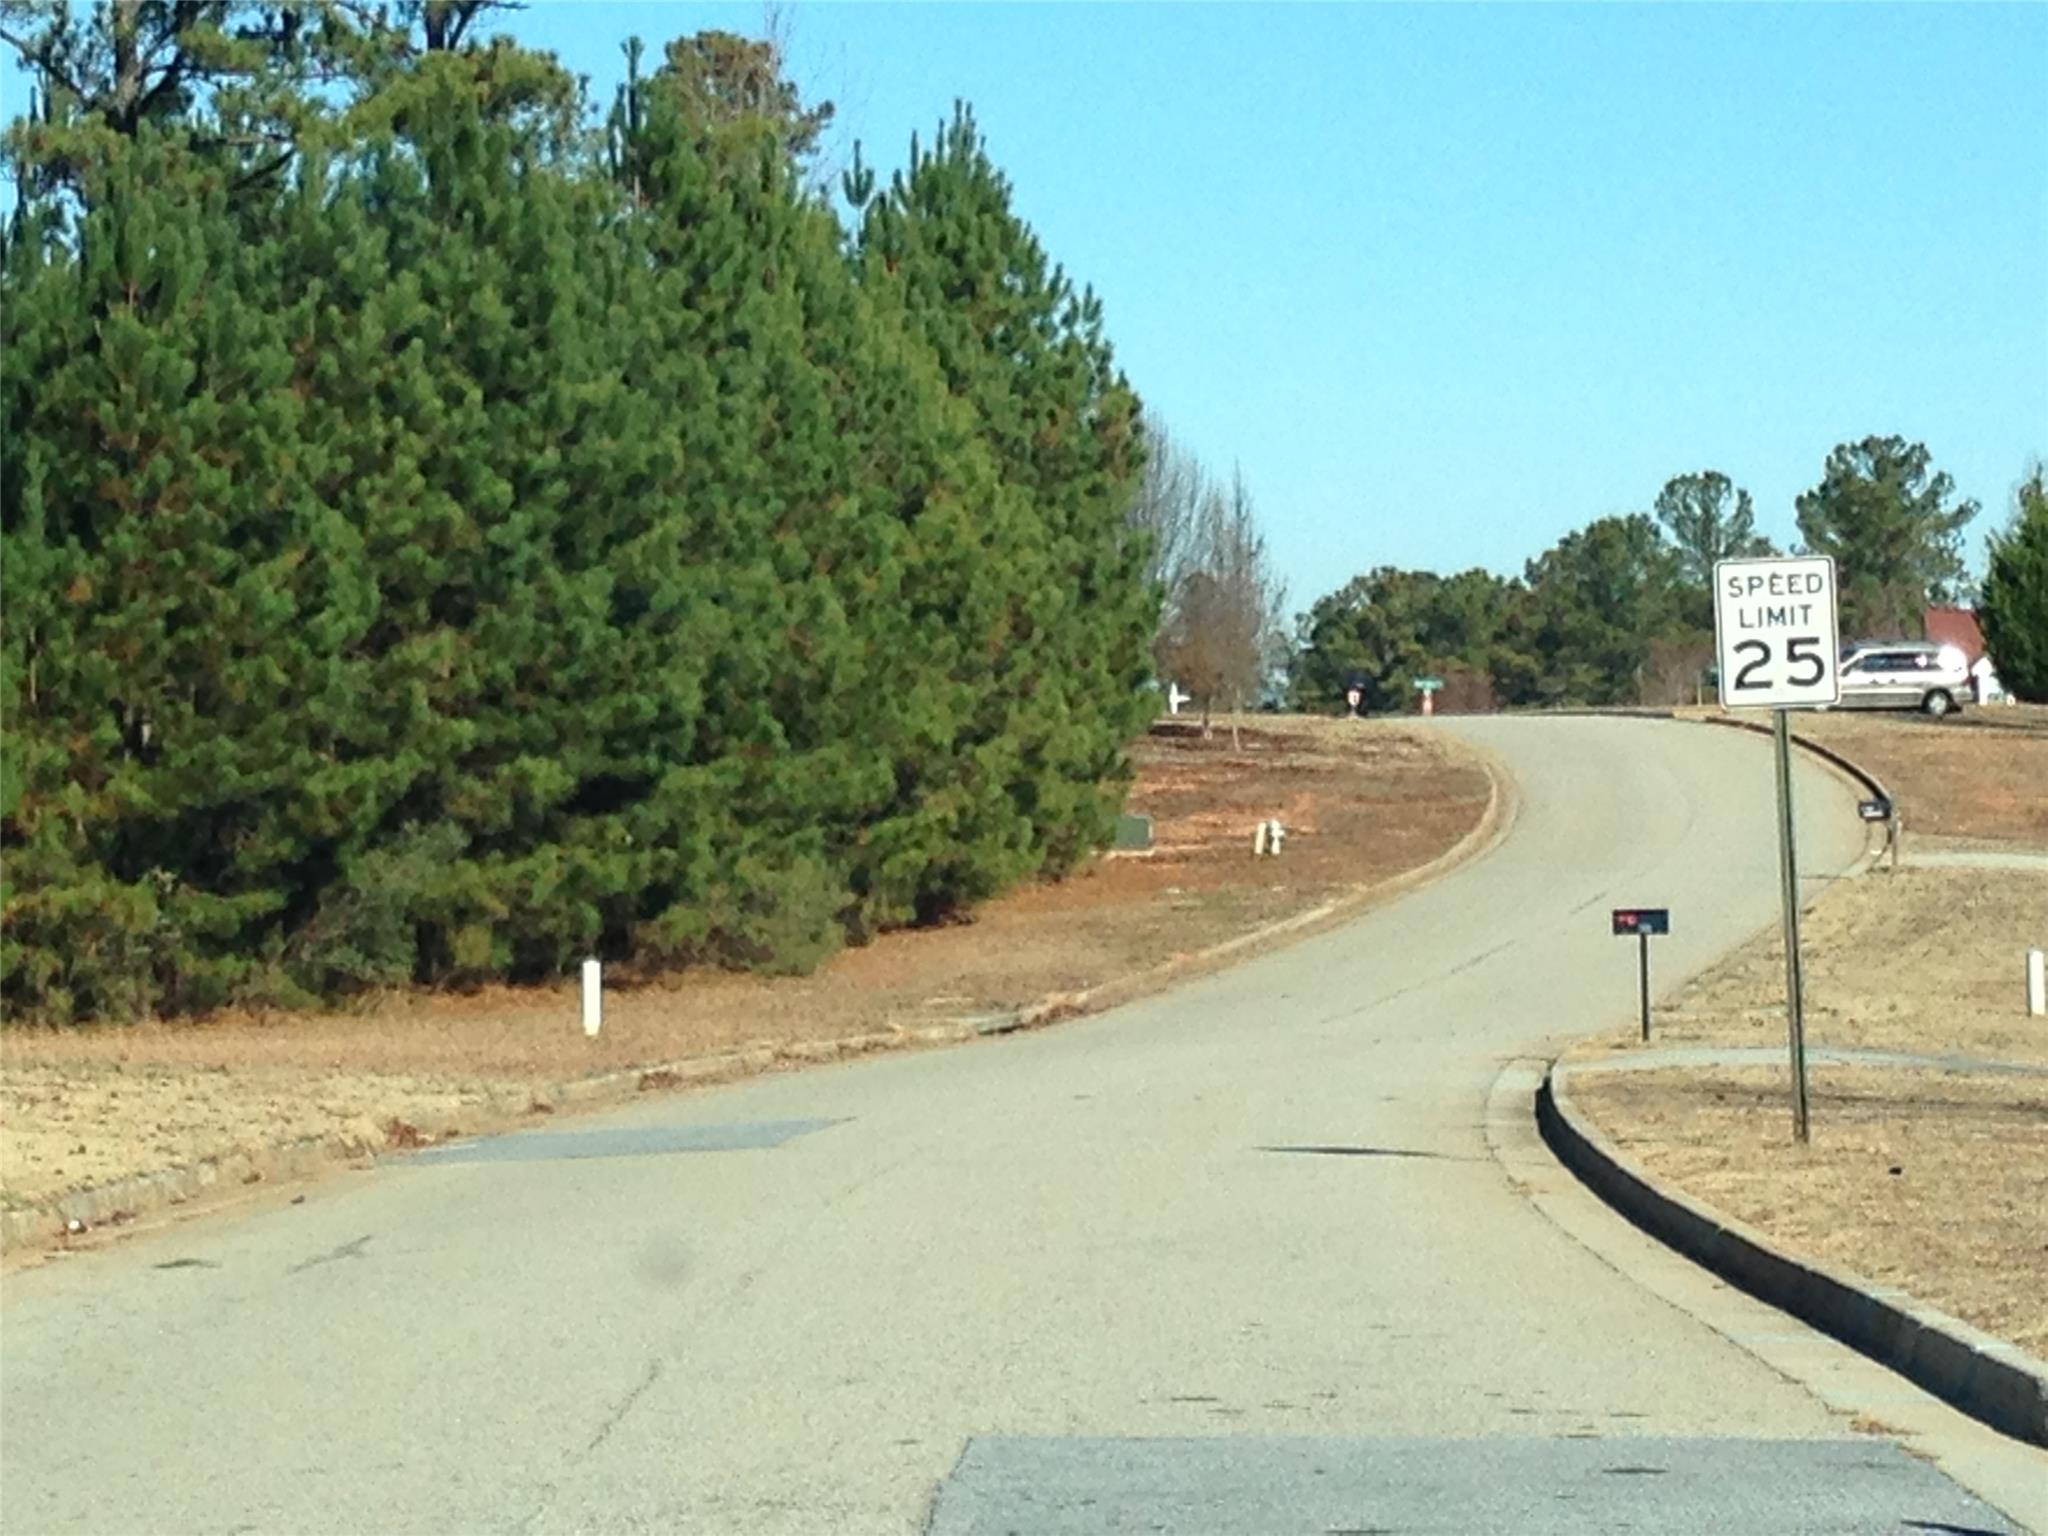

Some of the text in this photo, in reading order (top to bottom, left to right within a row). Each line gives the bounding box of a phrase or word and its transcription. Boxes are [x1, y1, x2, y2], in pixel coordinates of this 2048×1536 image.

[1728, 572, 1823, 598] SPEED
[1739, 604, 1812, 628] LIMIT
[1733, 637, 1825, 690] 25
